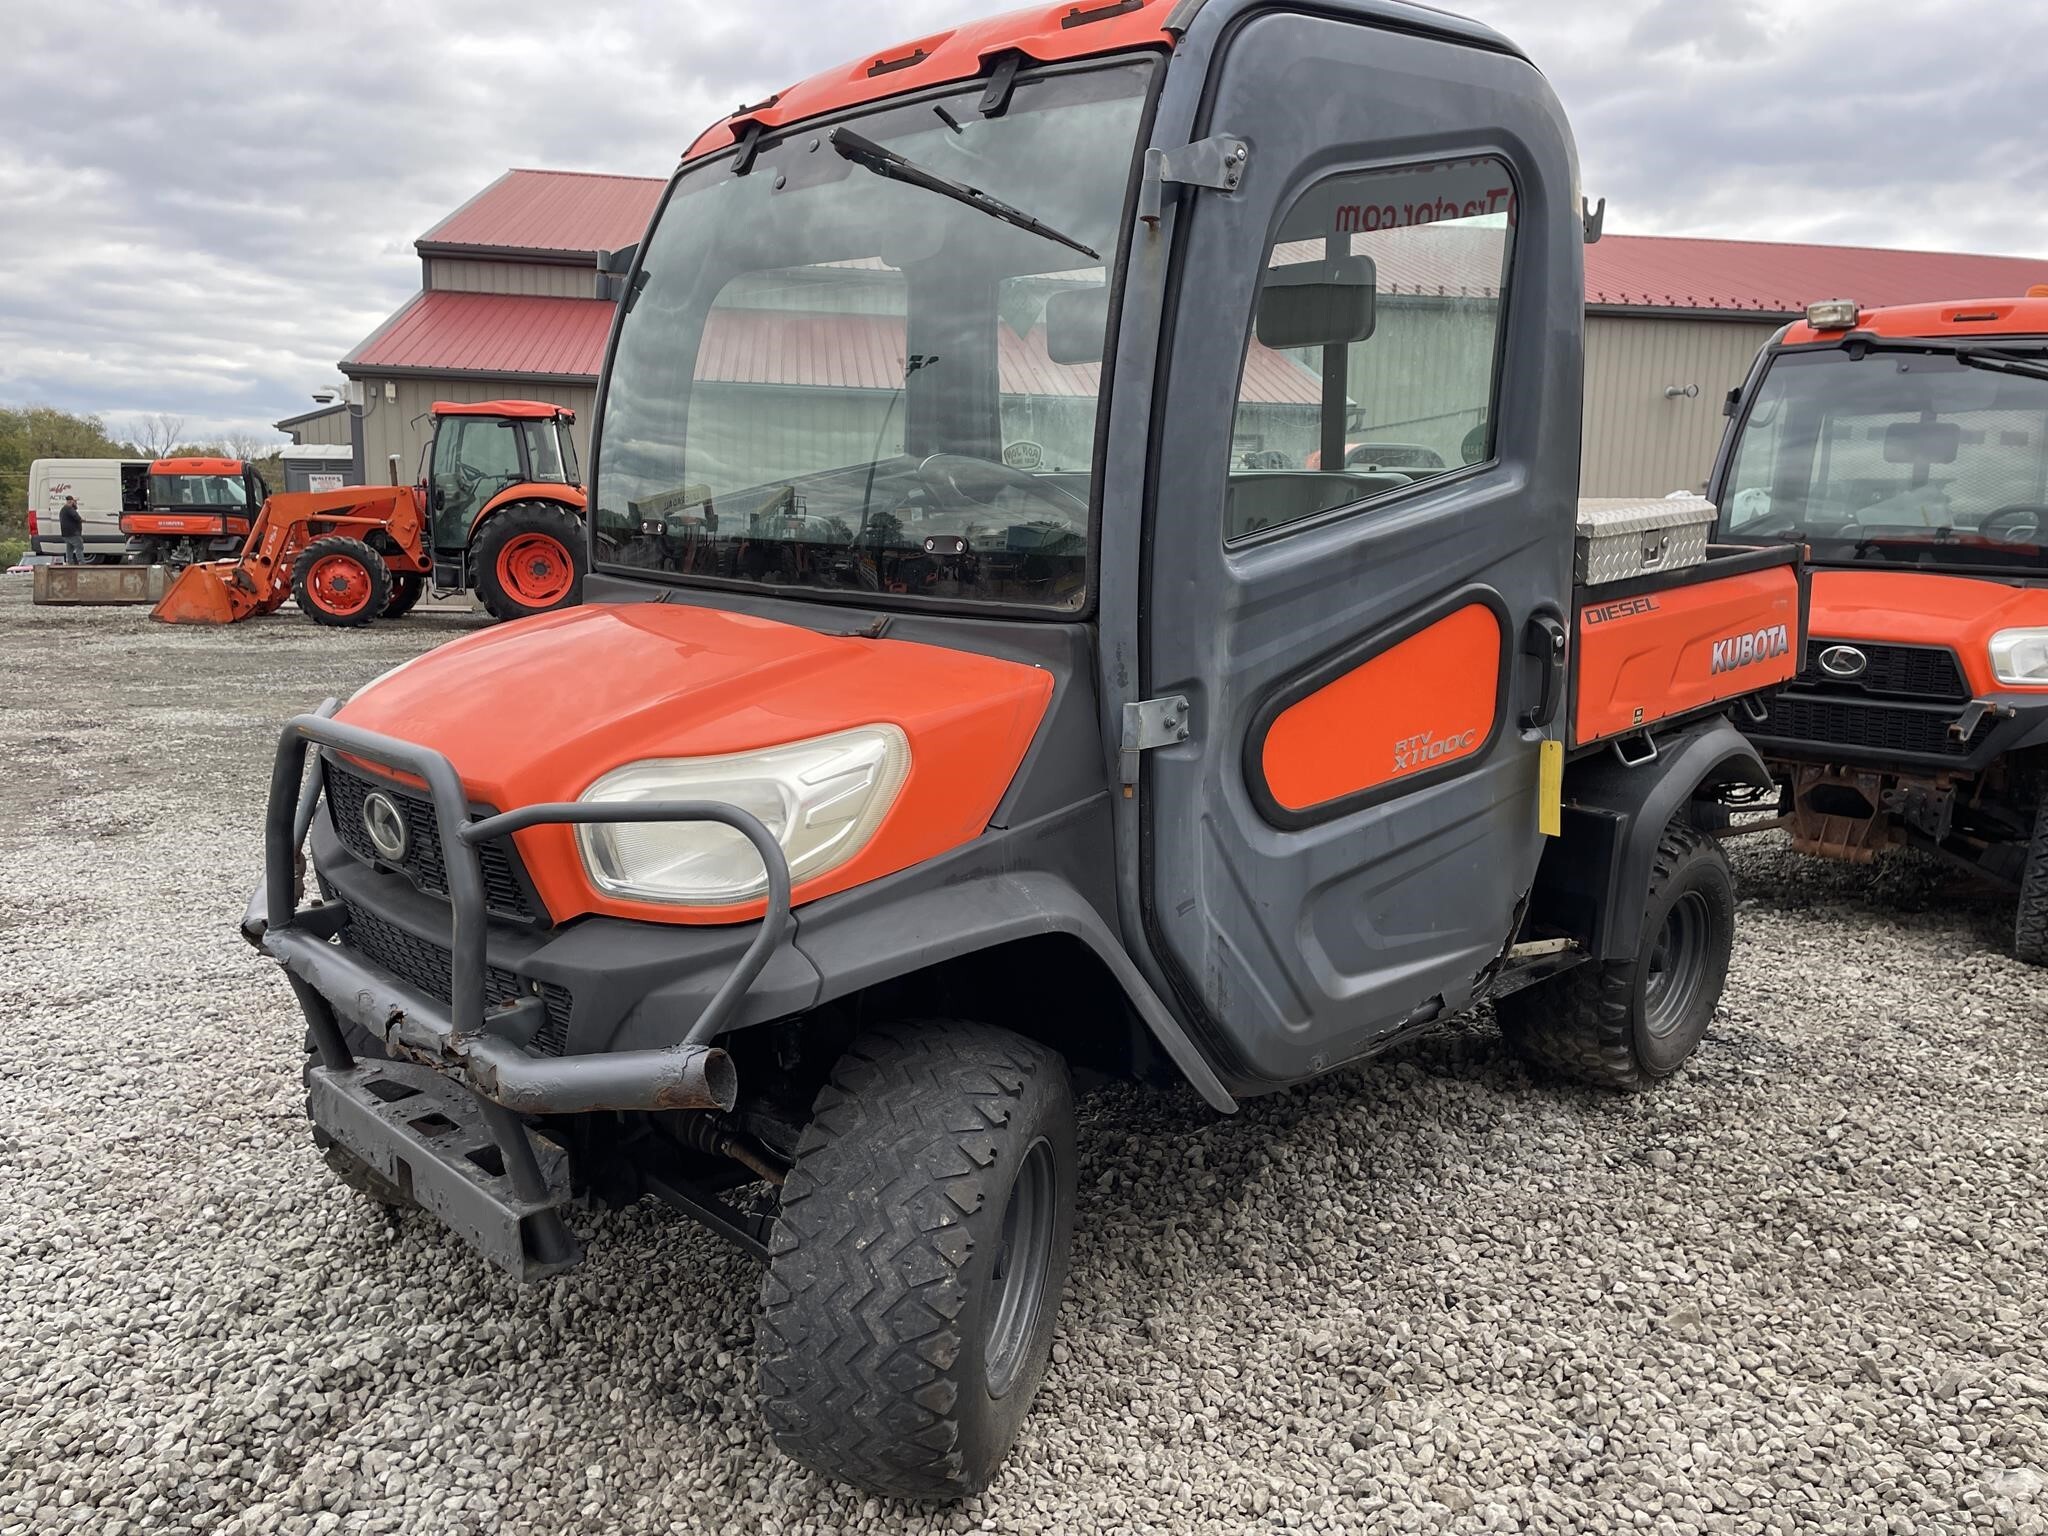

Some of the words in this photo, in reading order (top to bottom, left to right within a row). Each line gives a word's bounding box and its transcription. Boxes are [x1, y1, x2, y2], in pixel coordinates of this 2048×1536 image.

[1584, 598, 1660, 625] DIESEL
[1711, 624, 1789, 676] KUBOTA
[1391, 728, 1476, 773] X1100C
[1394, 730, 1433, 754] RTV
